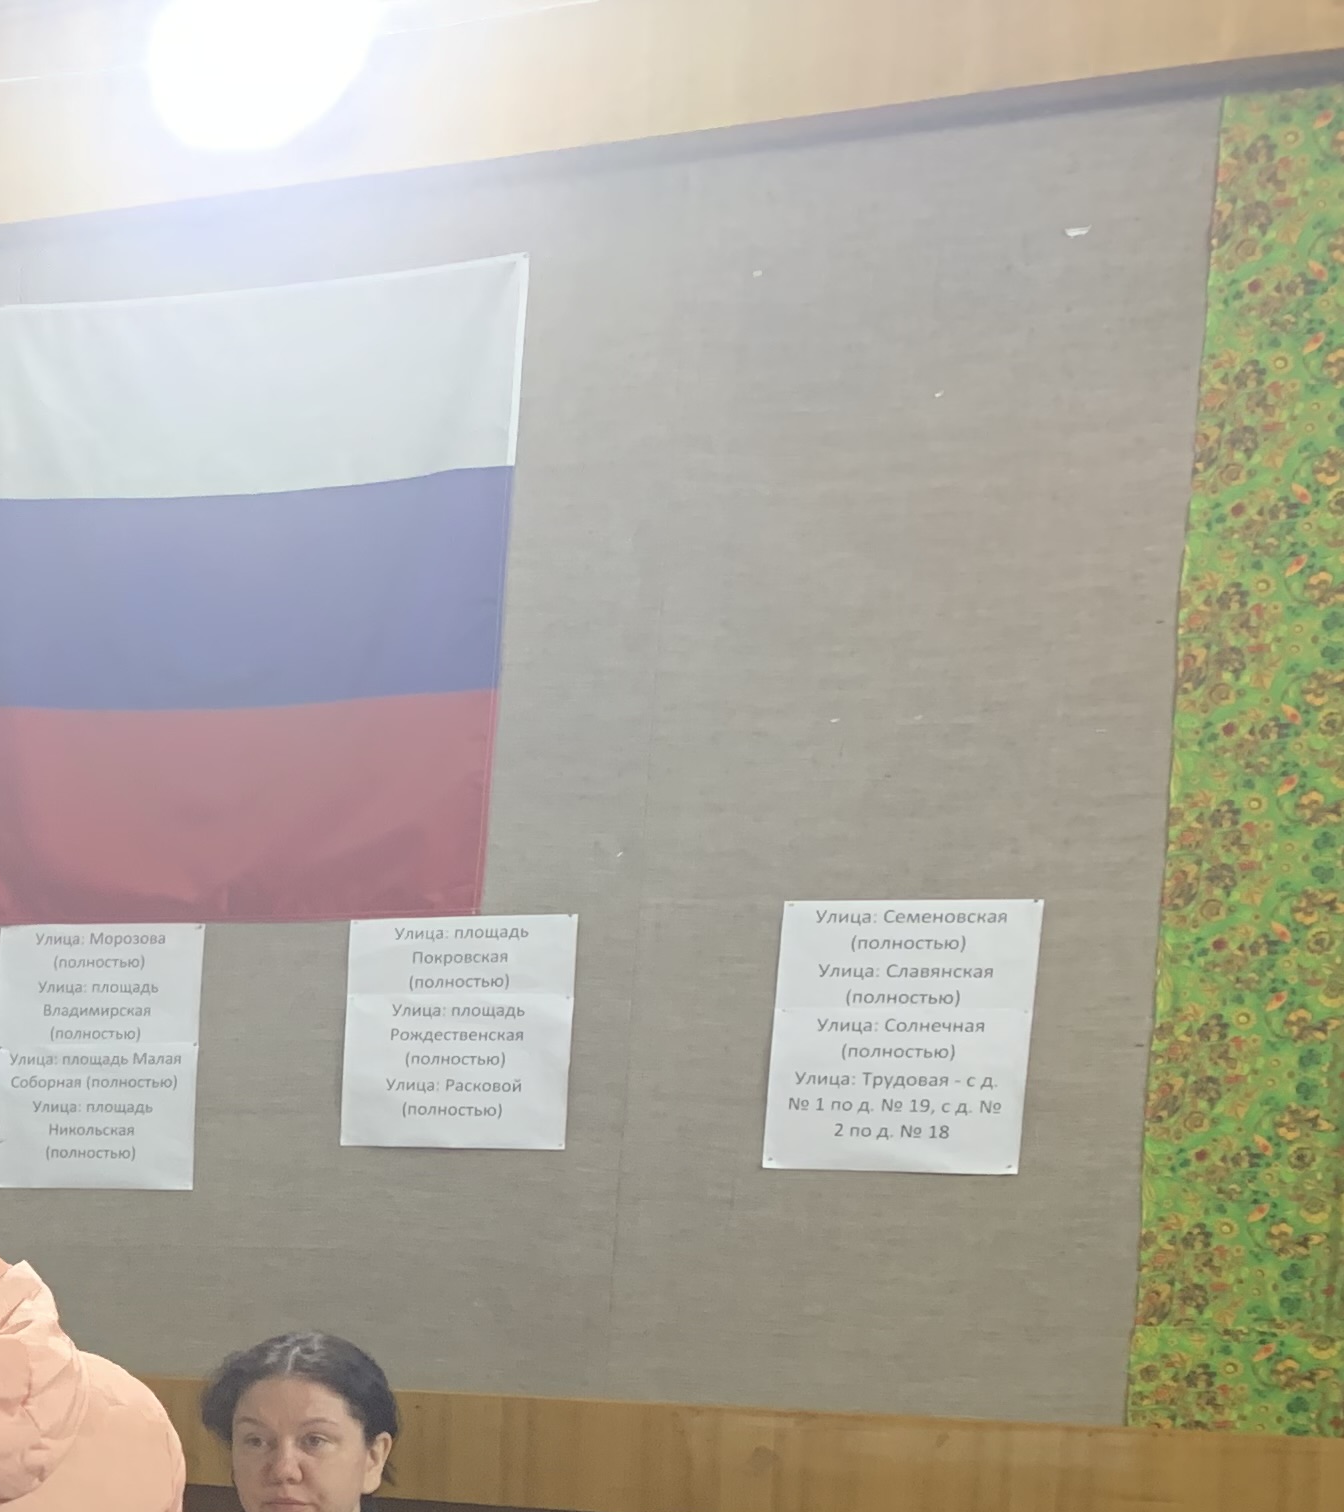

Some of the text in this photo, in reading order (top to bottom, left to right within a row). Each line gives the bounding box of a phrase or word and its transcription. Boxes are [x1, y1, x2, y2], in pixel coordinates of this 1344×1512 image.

[816, 910, 1007, 926] Улица: Семеновская
[35, 932, 166, 949] Улица: Морозова
[395, 927, 529, 941] Улица: площадь
[851, 936, 966, 952] (полностью)
[54, 956, 145, 971] (полностью)
[412, 951, 508, 967] Покровская
[818, 964, 993, 979] Улица: Славянская
[38, 981, 159, 996] Улица: площадь
[409, 974, 509, 992] (полностью)
[846, 990, 961, 1006] (полностью)
[43, 1004, 151, 1020] Владимирская
[392, 1004, 525, 1019] Улица: площадь
[817, 1018, 985, 1033] Улица: Солнечная
[50, 1027, 141, 1042] (полностью)
[390, 1028, 524, 1043] Рождественская
[9, 1053, 182, 1067] Улица: площадь Малая
[405, 1052, 506, 1068] (полностью)
[842, 1044, 955, 1061] (полностью)
[11, 1075, 177, 1091] Соборная (полностью)
[386, 1079, 522, 1093] Улица: Расковой
[795, 1071, 856, 1086] Улица:
[862, 1072, 948, 1090] Трудовая
[966, 1075, 976, 1087] с
[980, 1075, 998, 1090] д.
[32, 1101, 153, 1116] Улица: площадь
[402, 1102, 503, 1118] (полностью)
[788, 1097, 1002, 1116] № 1 по д. № 19, с д. №
[49, 1124, 135, 1137] Никольская
[834, 1124, 949, 1140] 2 по д. № 18
[45, 1146, 136, 1161] (полностью)
